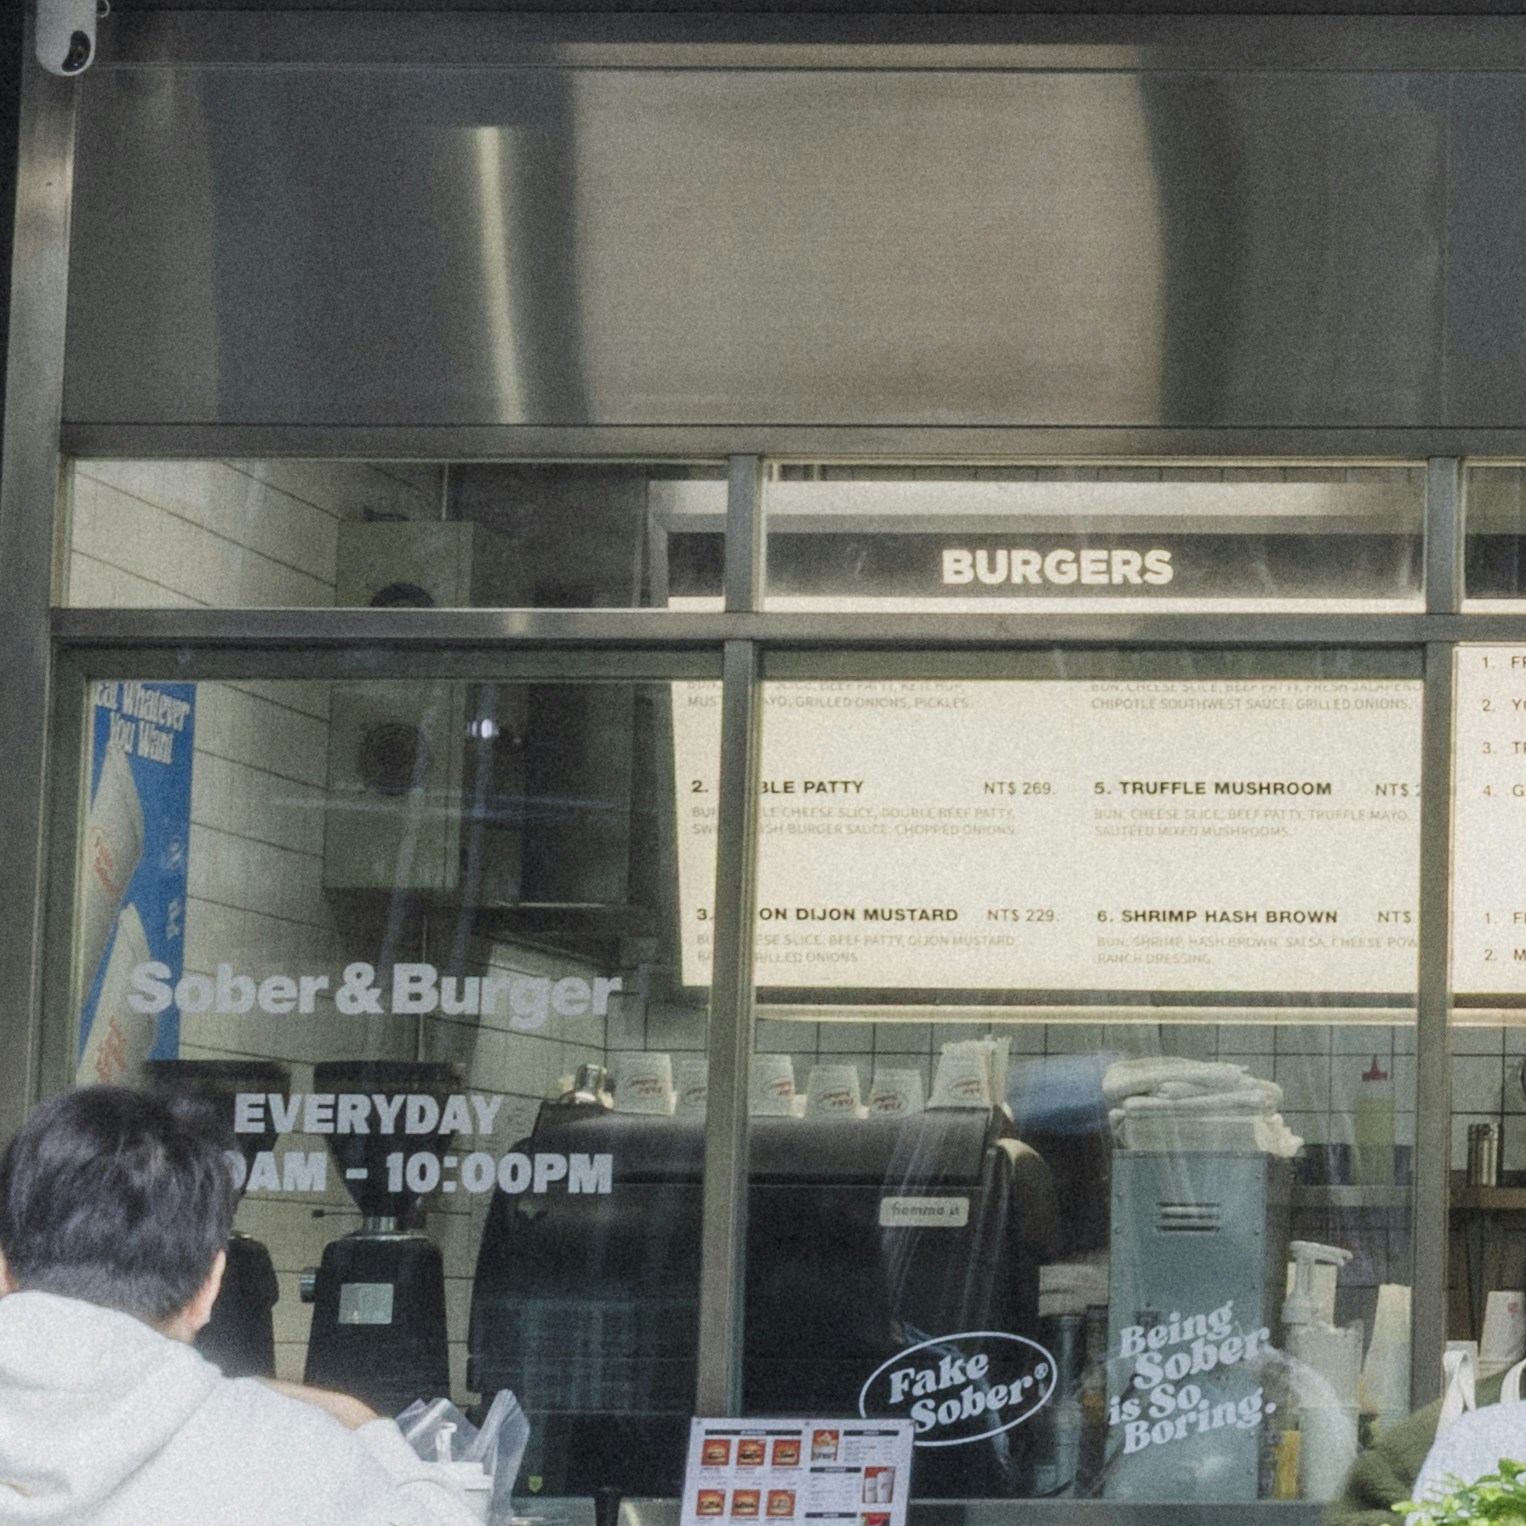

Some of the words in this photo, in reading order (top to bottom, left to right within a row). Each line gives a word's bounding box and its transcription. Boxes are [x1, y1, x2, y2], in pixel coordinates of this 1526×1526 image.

[942, 549, 1174, 585] BURGERS
[691, 779, 709, 794] 2.
[803, 780, 864, 795] PATTY
[984, 781, 1016, 796] NT$
[1094, 781, 1112, 796] 5.
[1119, 781, 1206, 796] TRUFFLE
[1213, 781, 1332, 796] MUSHROOM
[1374, 782, 1409, 798] NT$
[795, 907, 857, 922] DIJON
[863, 907, 960, 923] MUSTARD
[987, 908, 1020, 923] NT$
[1096, 909, 1114, 924] 6.
[1121, 909, 1198, 924] SHRIMP
[1204, 909, 1258, 924] HASH
[1265, 910, 1338, 925] BROWN
[1377, 910, 1412, 925] NT$
[233, 1092, 506, 1135] EVERYDAY
[386, 1151, 614, 1194] 10:00PM
[1119, 1300, 1234, 1359] Being
[888, 1353, 990, 1405] Fake
[1132, 1327, 1271, 1390] Sober
[1109, 1395, 1142, 1427] is
[1148, 1383, 1202, 1419] So
[1122, 1387, 1277, 1455] Boring.
